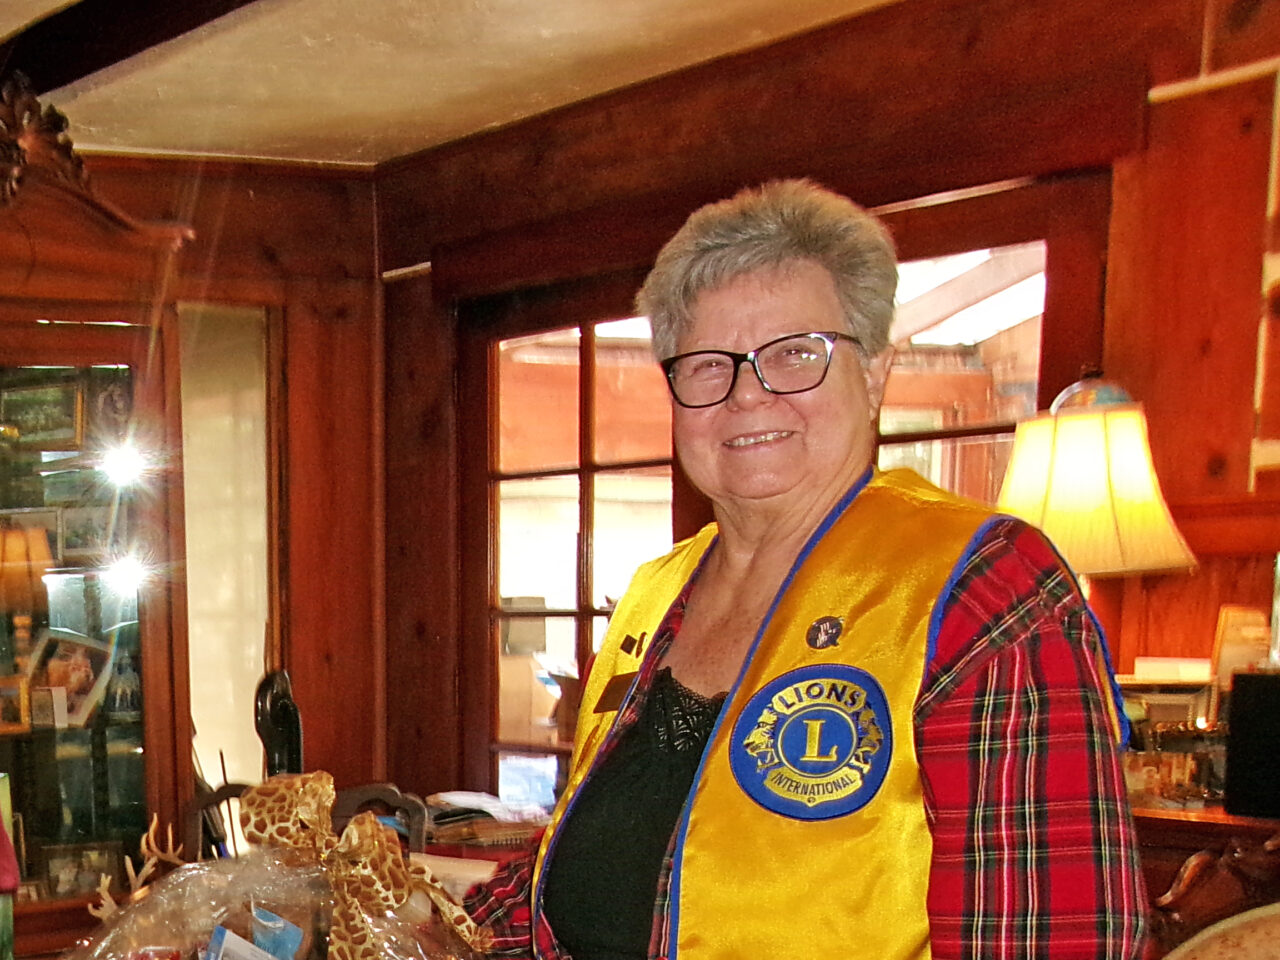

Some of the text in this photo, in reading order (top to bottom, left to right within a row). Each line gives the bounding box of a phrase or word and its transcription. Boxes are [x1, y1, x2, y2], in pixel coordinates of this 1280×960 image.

[778, 682, 861, 710] LIONS
[800, 719, 839, 762] L
[770, 771, 857, 797] INTERNATIONAL
